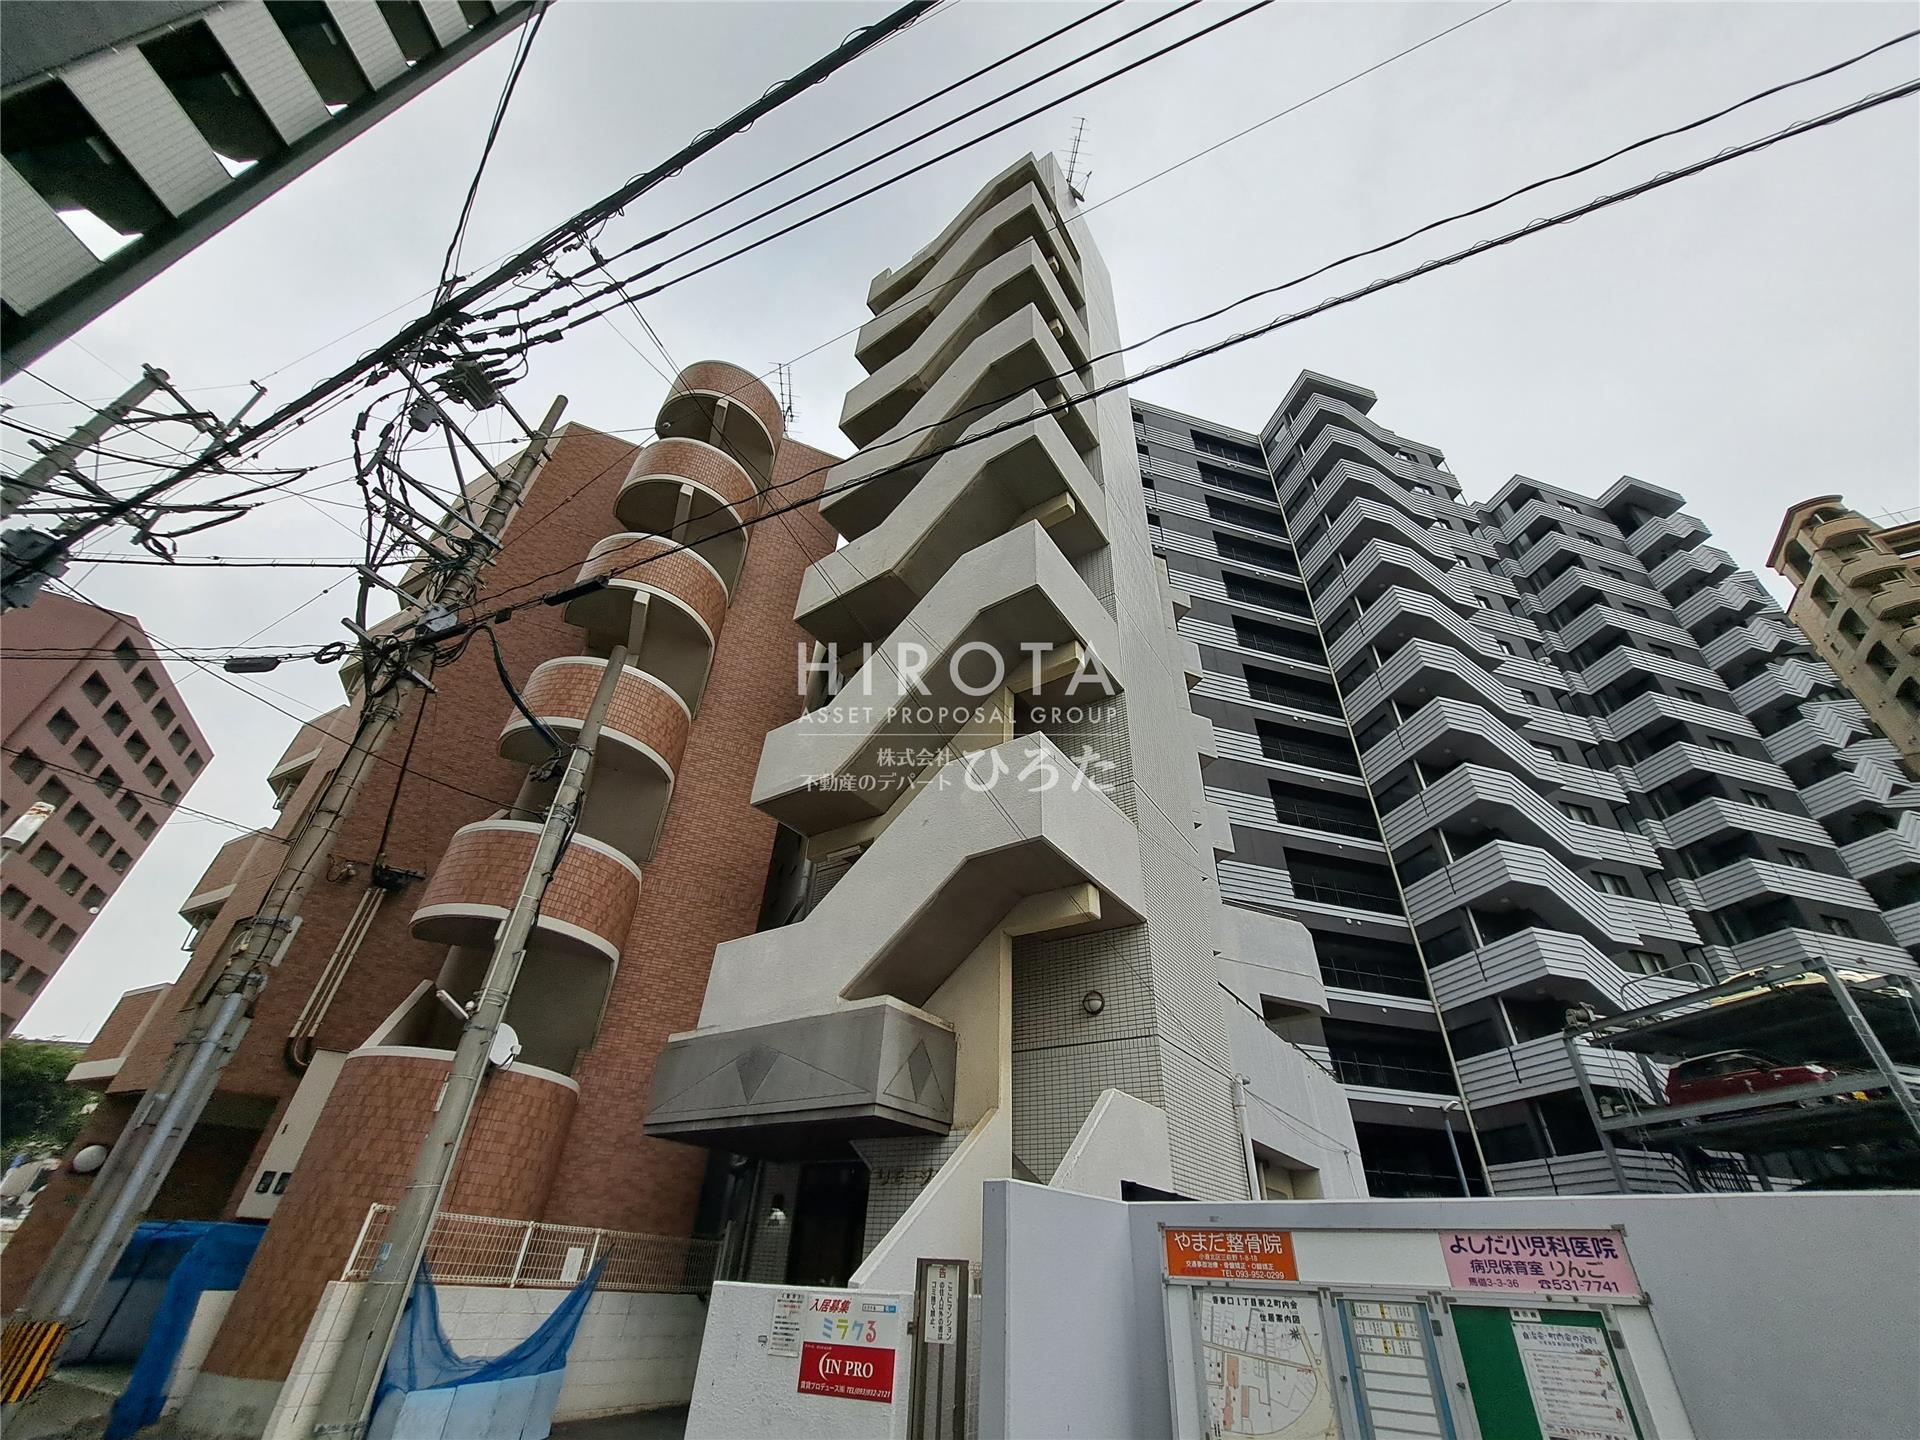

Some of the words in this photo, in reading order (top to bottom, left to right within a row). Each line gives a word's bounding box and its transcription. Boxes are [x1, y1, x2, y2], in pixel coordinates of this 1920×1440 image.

[1174, 1232, 1283, 1254] やまだ整骨院
[1450, 1234, 1619, 1260] よしだ小児科医院
[1221, 1269, 1236, 1277] TEL
[1235, 1270, 1285, 1280] 093-952-0299
[1470, 1259, 1545, 1276] 病児保育室
[1549, 1260, 1606, 1279] りんご
[1551, 1280, 1620, 1293] 531-7741
[809, 1298, 852, 1314] 入居募集
[844, 1360, 874, 1379] PRO
